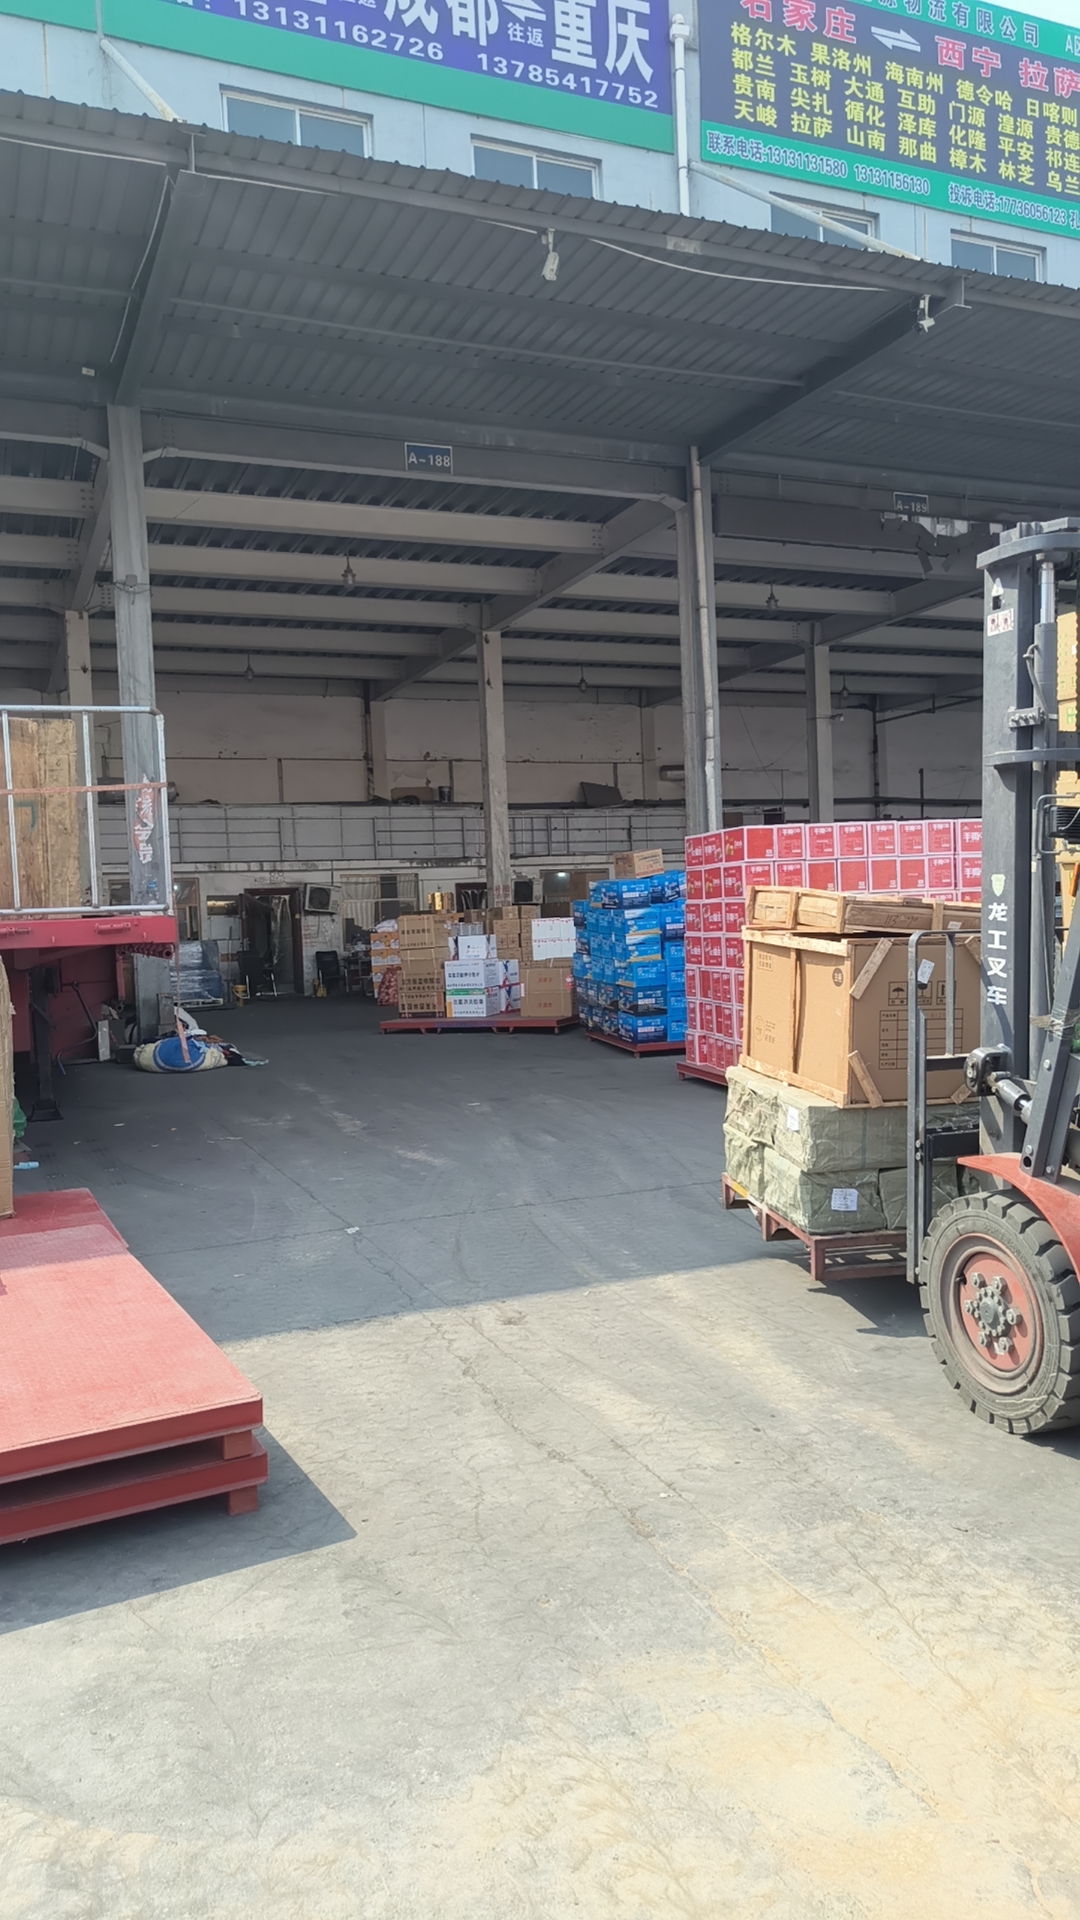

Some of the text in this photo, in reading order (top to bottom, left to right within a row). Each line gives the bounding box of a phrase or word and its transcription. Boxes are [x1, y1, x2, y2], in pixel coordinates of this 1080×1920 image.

[234, 0, 659, 108] 13131162726 13785417752
[507, 22, 544, 48] 往返
[552, 0, 653, 84] 重庆
[731, 22, 1077, 128] 格尔木 果洛州 海南州 德令哈 日喀则
[740, 0, 1080, 98] 石家庄 西宁 拉萨
[732, 47, 1080, 150] 都兰 玉树 大通 互助 门源 湟源 贵德
[733, 73, 1080, 173] 贵南 尖扎 循化 泽库 化隆 平安 祁连
[707, 130, 848, 178] 联系电话:13131131580
[854, 165, 930, 195] 13131156130
[948, 182, 1067, 225] 投诉电话:17736056123
[734, 99, 1080, 196] 天峻 拉萨 山南 那曲 樟木 林芝 乌兰
[408, 452, 450, 467] A-188
[897, 500, 927, 513] A-189
[987, 902, 1008, 1005] 龙工叉车
